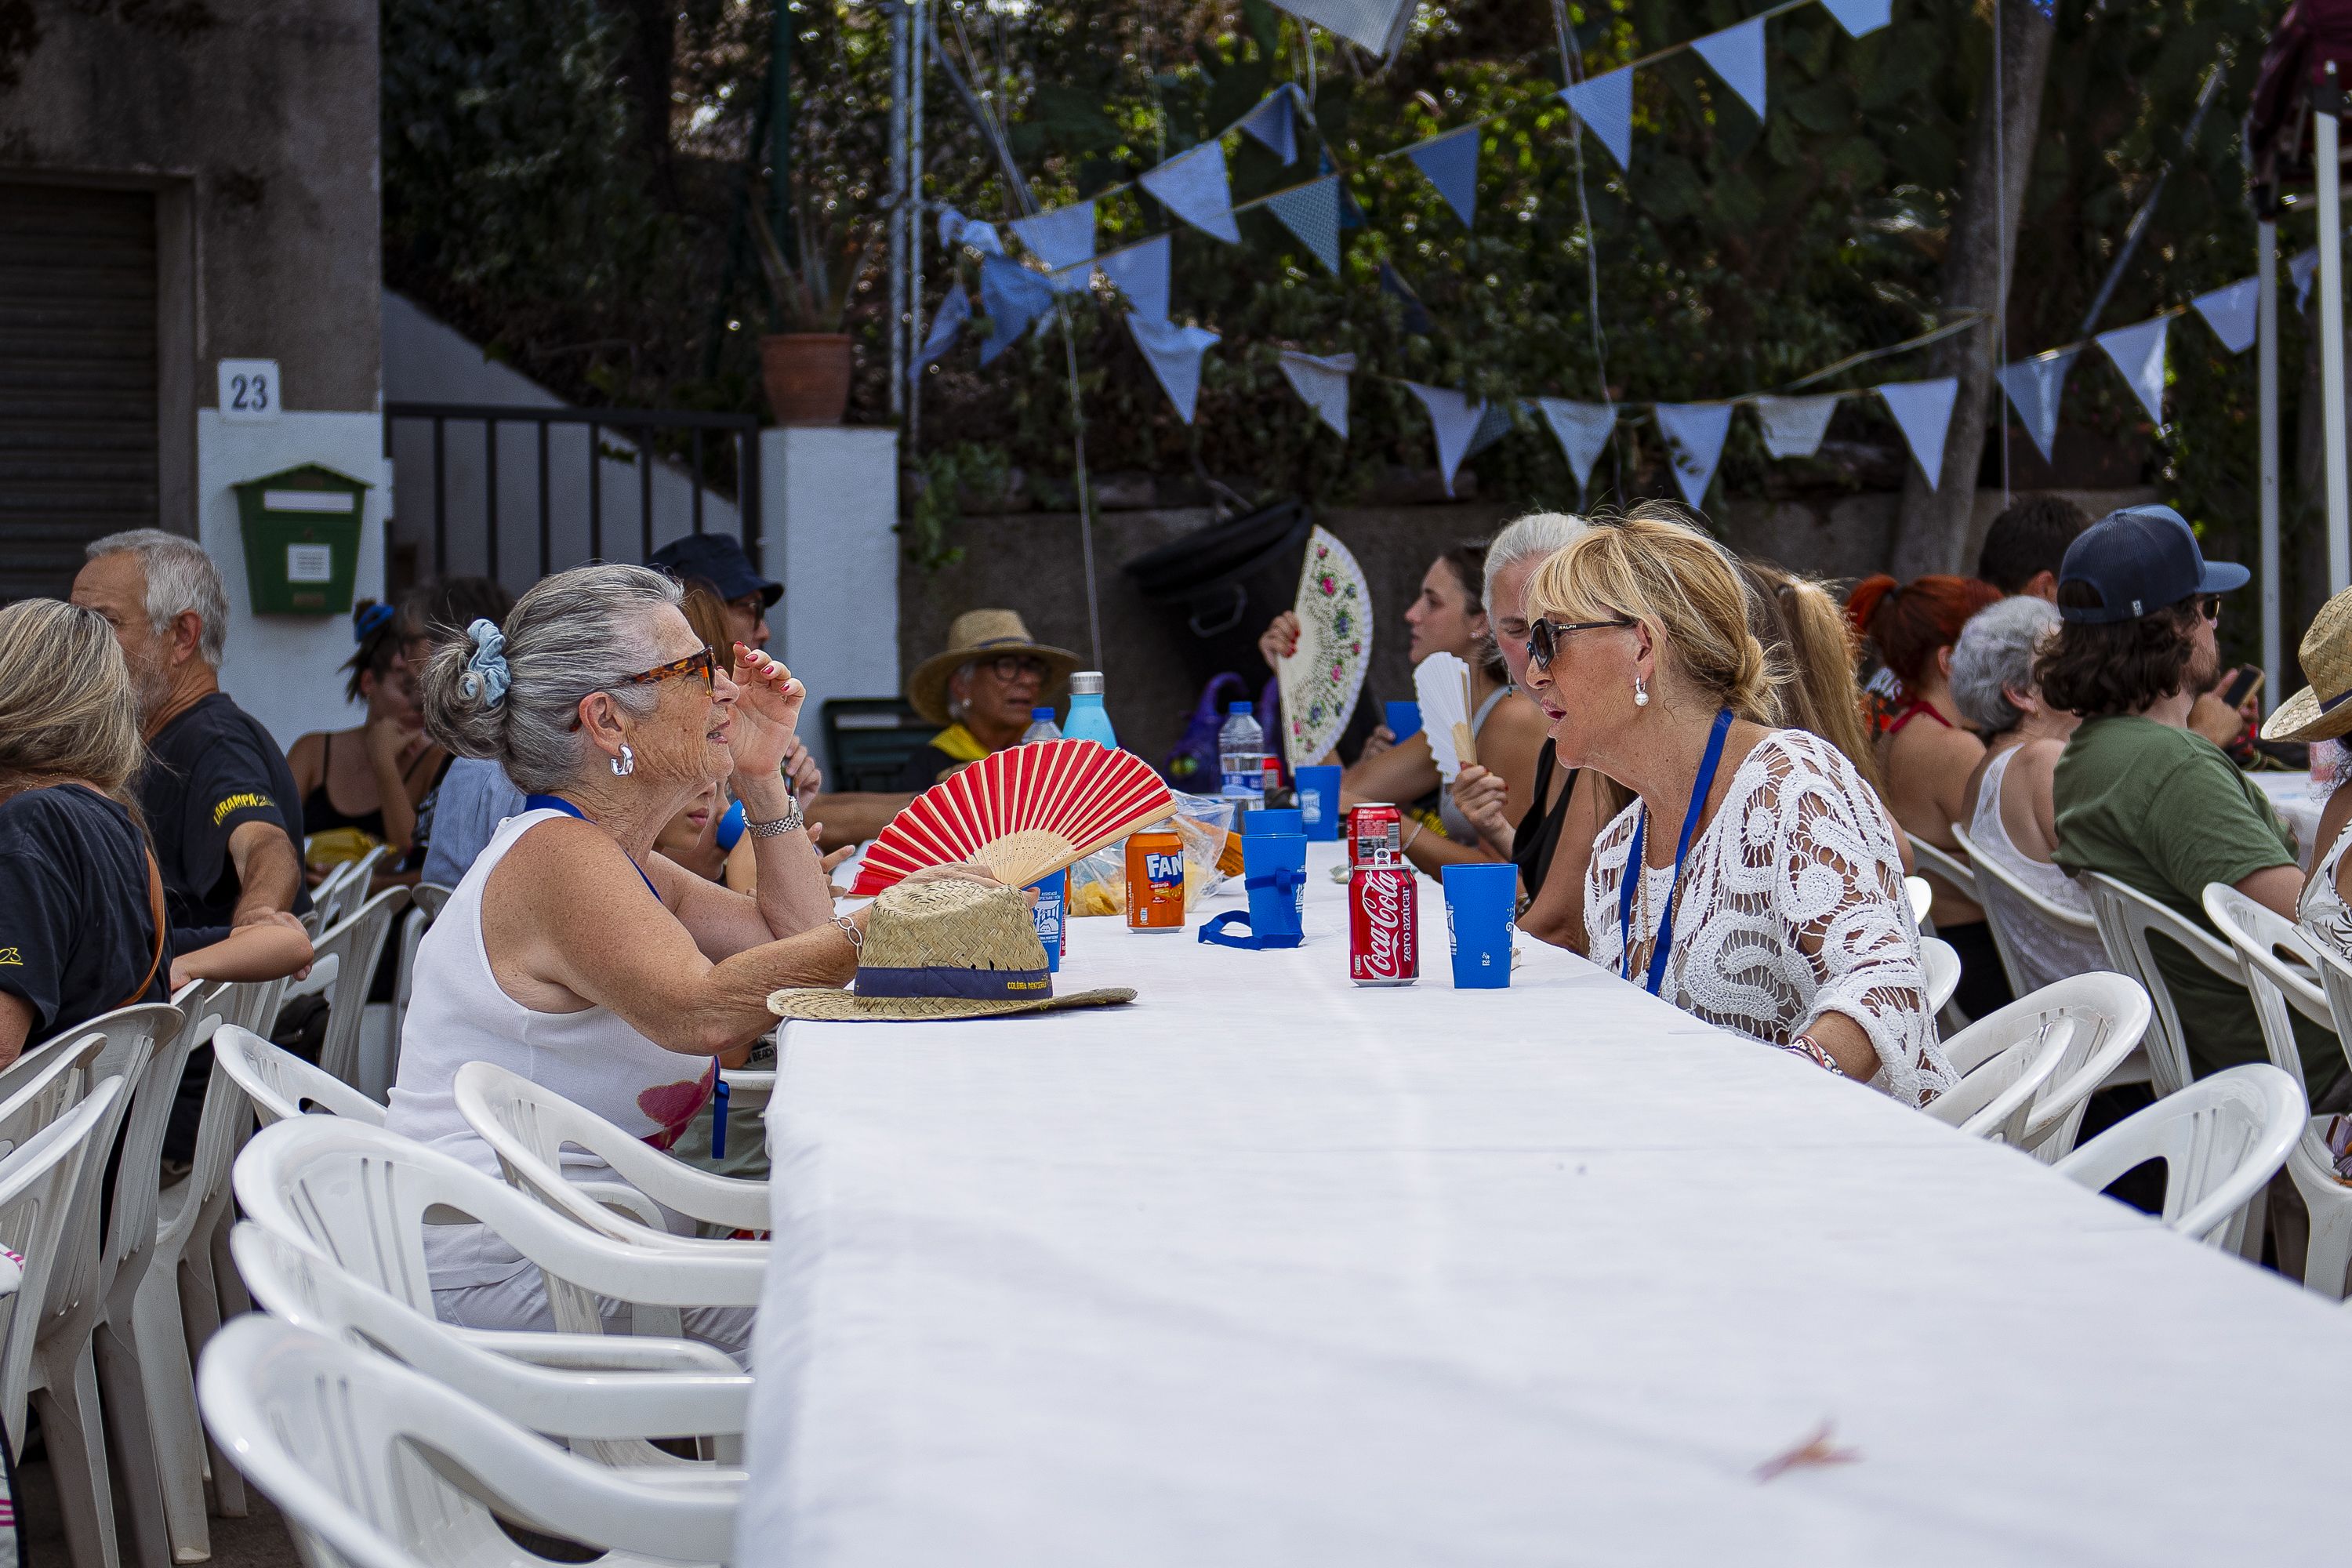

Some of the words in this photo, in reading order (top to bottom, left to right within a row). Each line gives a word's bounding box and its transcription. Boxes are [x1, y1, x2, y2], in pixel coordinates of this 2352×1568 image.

[231, 373, 267, 412] 23
[1146, 850, 1184, 878] FAN
[1401, 887, 1410, 931] azúcar
